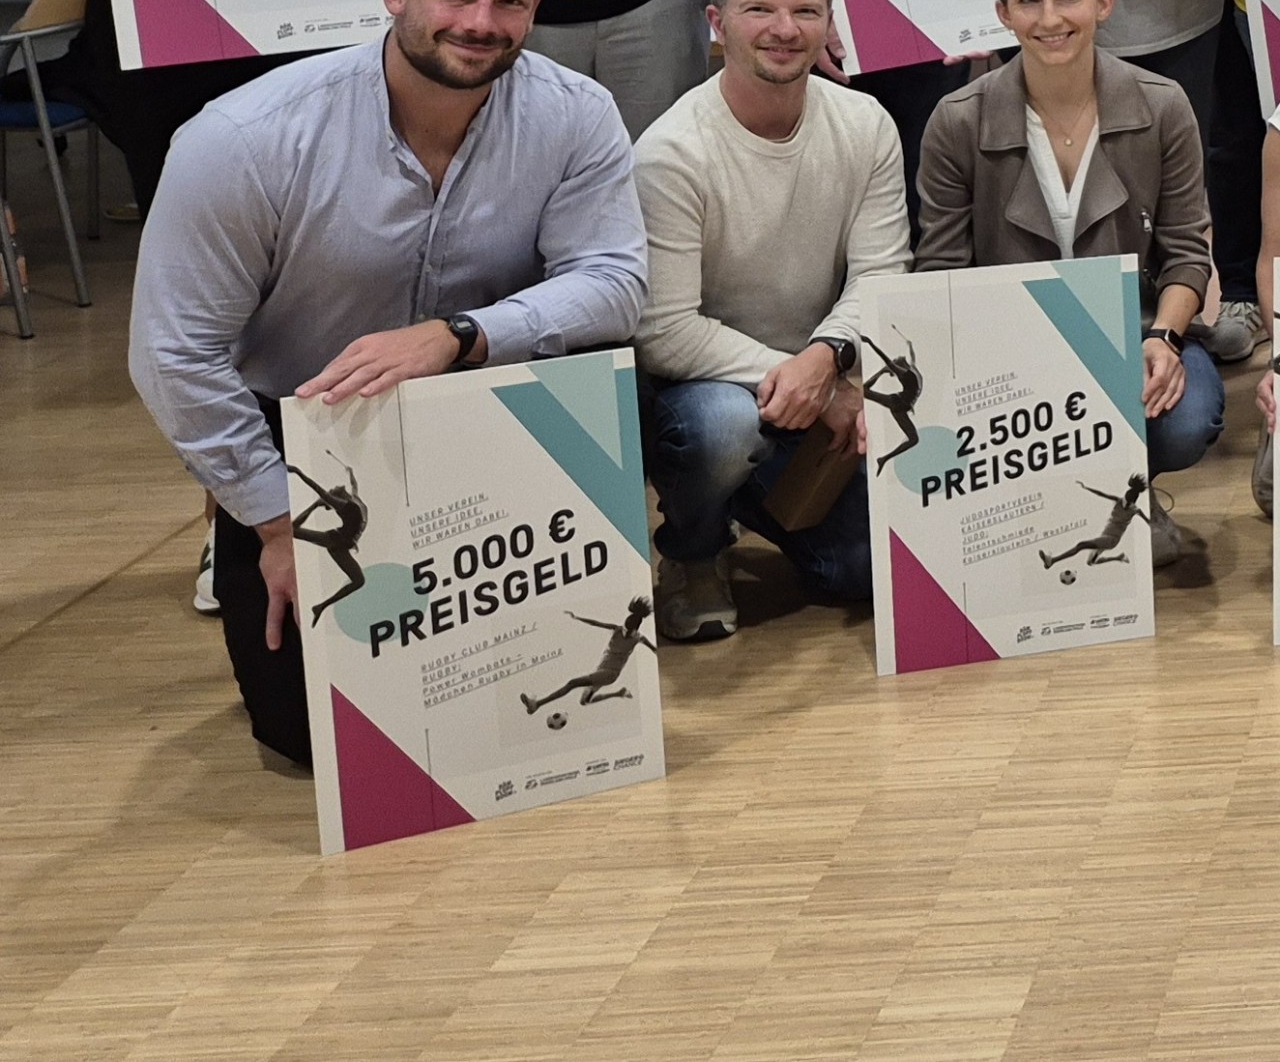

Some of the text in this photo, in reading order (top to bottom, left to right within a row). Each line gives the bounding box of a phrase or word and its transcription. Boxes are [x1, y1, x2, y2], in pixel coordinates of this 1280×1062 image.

[921, 421, 1113, 508] PREISGELD
[956, 391, 1087, 459] 2.500 €
[412, 509, 576, 596] 5.000 €
[369, 540, 608, 659] PREISGELD
[494, 625, 526, 643] MAINZ
